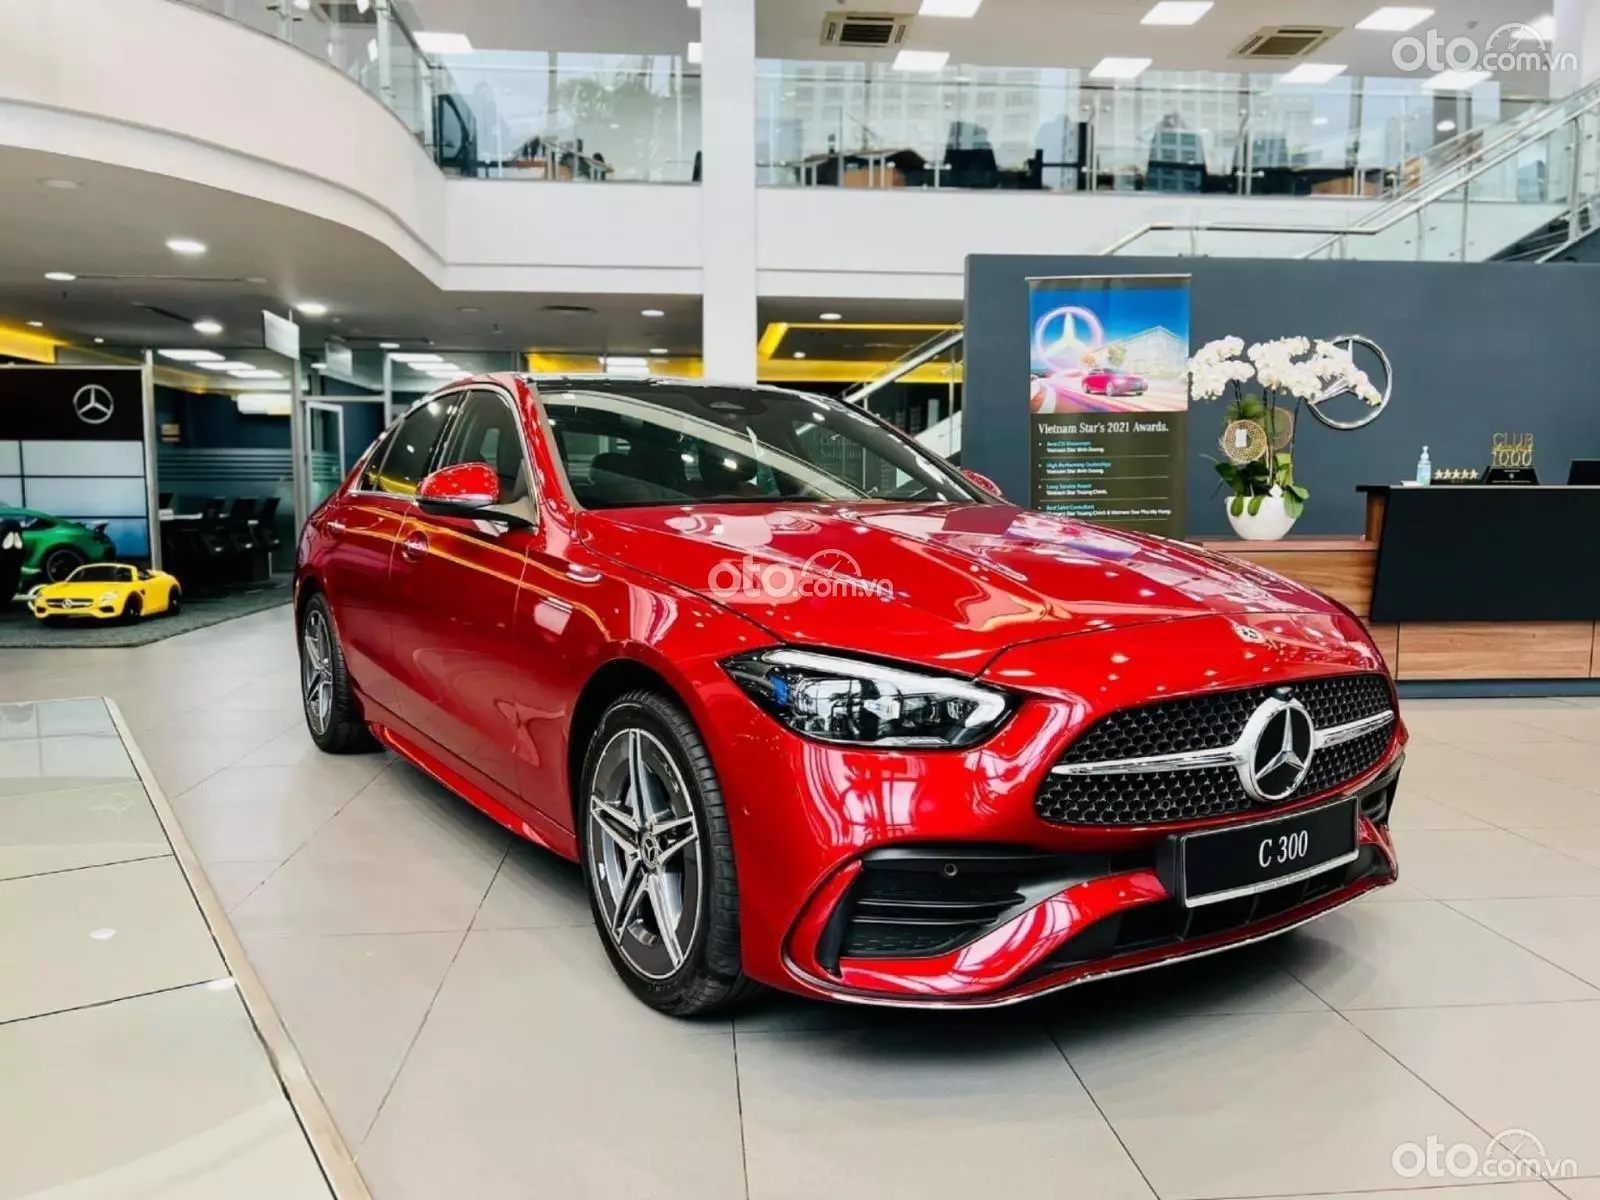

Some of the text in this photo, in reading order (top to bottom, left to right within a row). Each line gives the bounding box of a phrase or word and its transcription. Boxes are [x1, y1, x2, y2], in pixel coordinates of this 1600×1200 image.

[1038, 420, 1169, 434] Vietnam Star's 2021 Awards.
[1258, 830, 1309, 868] C 300
